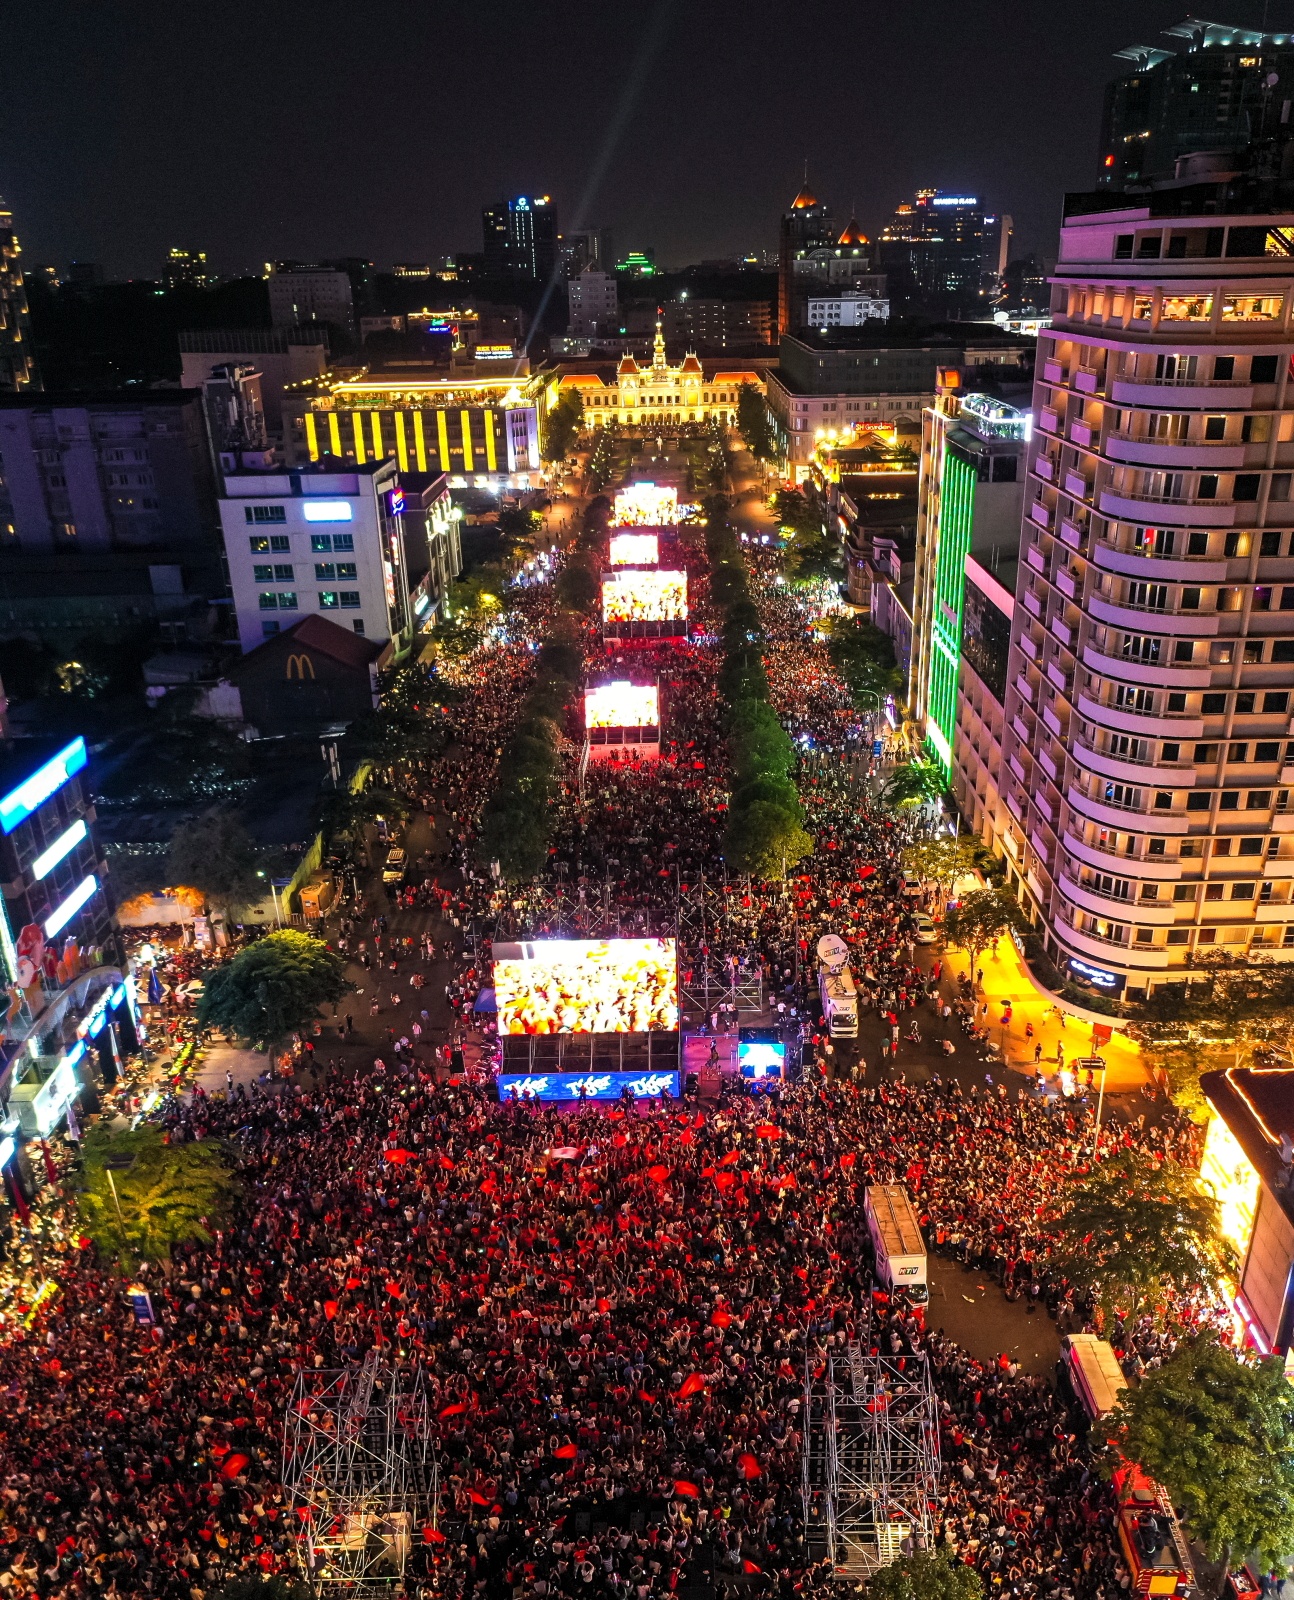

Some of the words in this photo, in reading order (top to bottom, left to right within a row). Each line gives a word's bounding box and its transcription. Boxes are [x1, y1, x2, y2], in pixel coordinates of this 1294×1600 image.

[865, 422, 892, 431] Garden
[823, 946, 840, 958] HTV
[503, 1076, 549, 1097] Tiger
[566, 1074, 611, 1096] Tiger
[628, 1073, 674, 1096] Tiger
[898, 1266, 919, 1276] HTV
